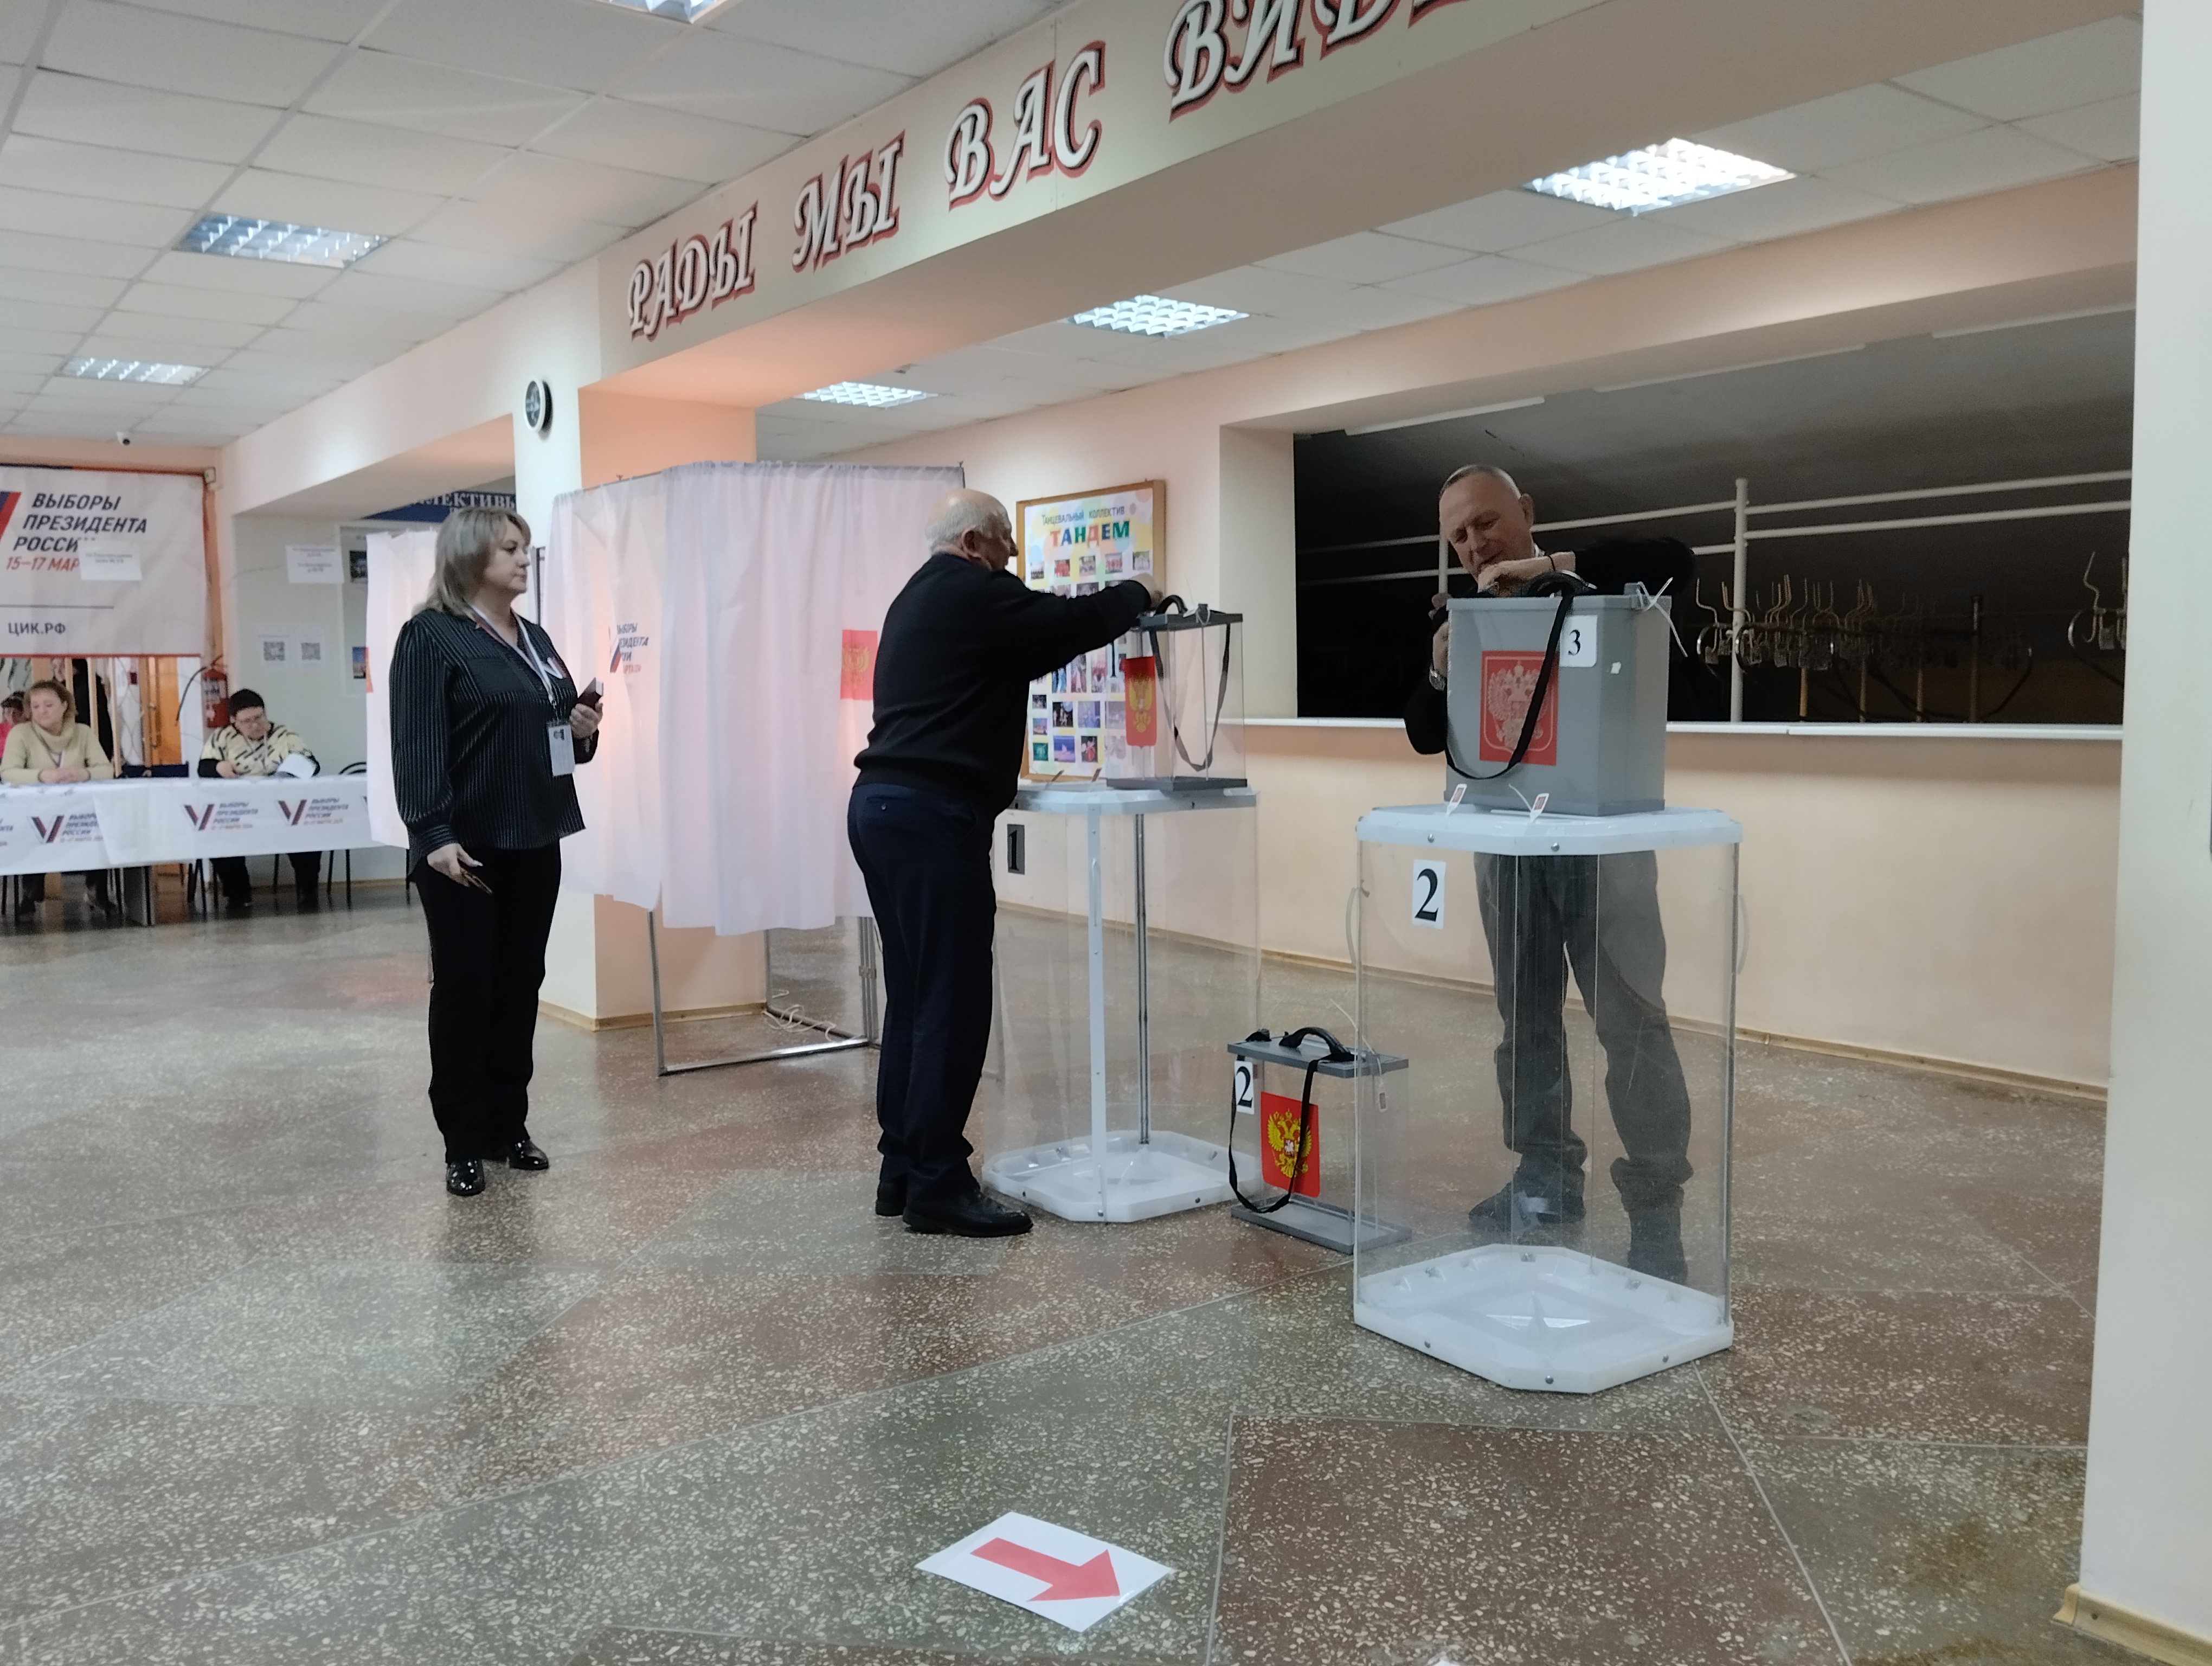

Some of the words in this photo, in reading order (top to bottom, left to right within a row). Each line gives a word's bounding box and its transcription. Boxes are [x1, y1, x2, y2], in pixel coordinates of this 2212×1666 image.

[627, 200, 758, 342] РАДЫ
[792, 129, 906, 273] МЫ
[943, 40, 1105, 213] ВАС
[31, 492, 121, 511] ВЫБОРЫ
[22, 514, 147, 534] ПРЕЗИДЕНТА
[1050, 519, 1130, 548] ТАНДЕМ
[13, 536, 82, 553] РОССИ
[47, 557, 80, 571] МАР
[8, 622, 66, 637] ЦИК.РФ
[1568, 629, 1581, 656] 3
[1008, 829, 1020, 872] 1
[1414, 868, 1439, 922] 2
[1236, 1066, 1253, 1108] 2
